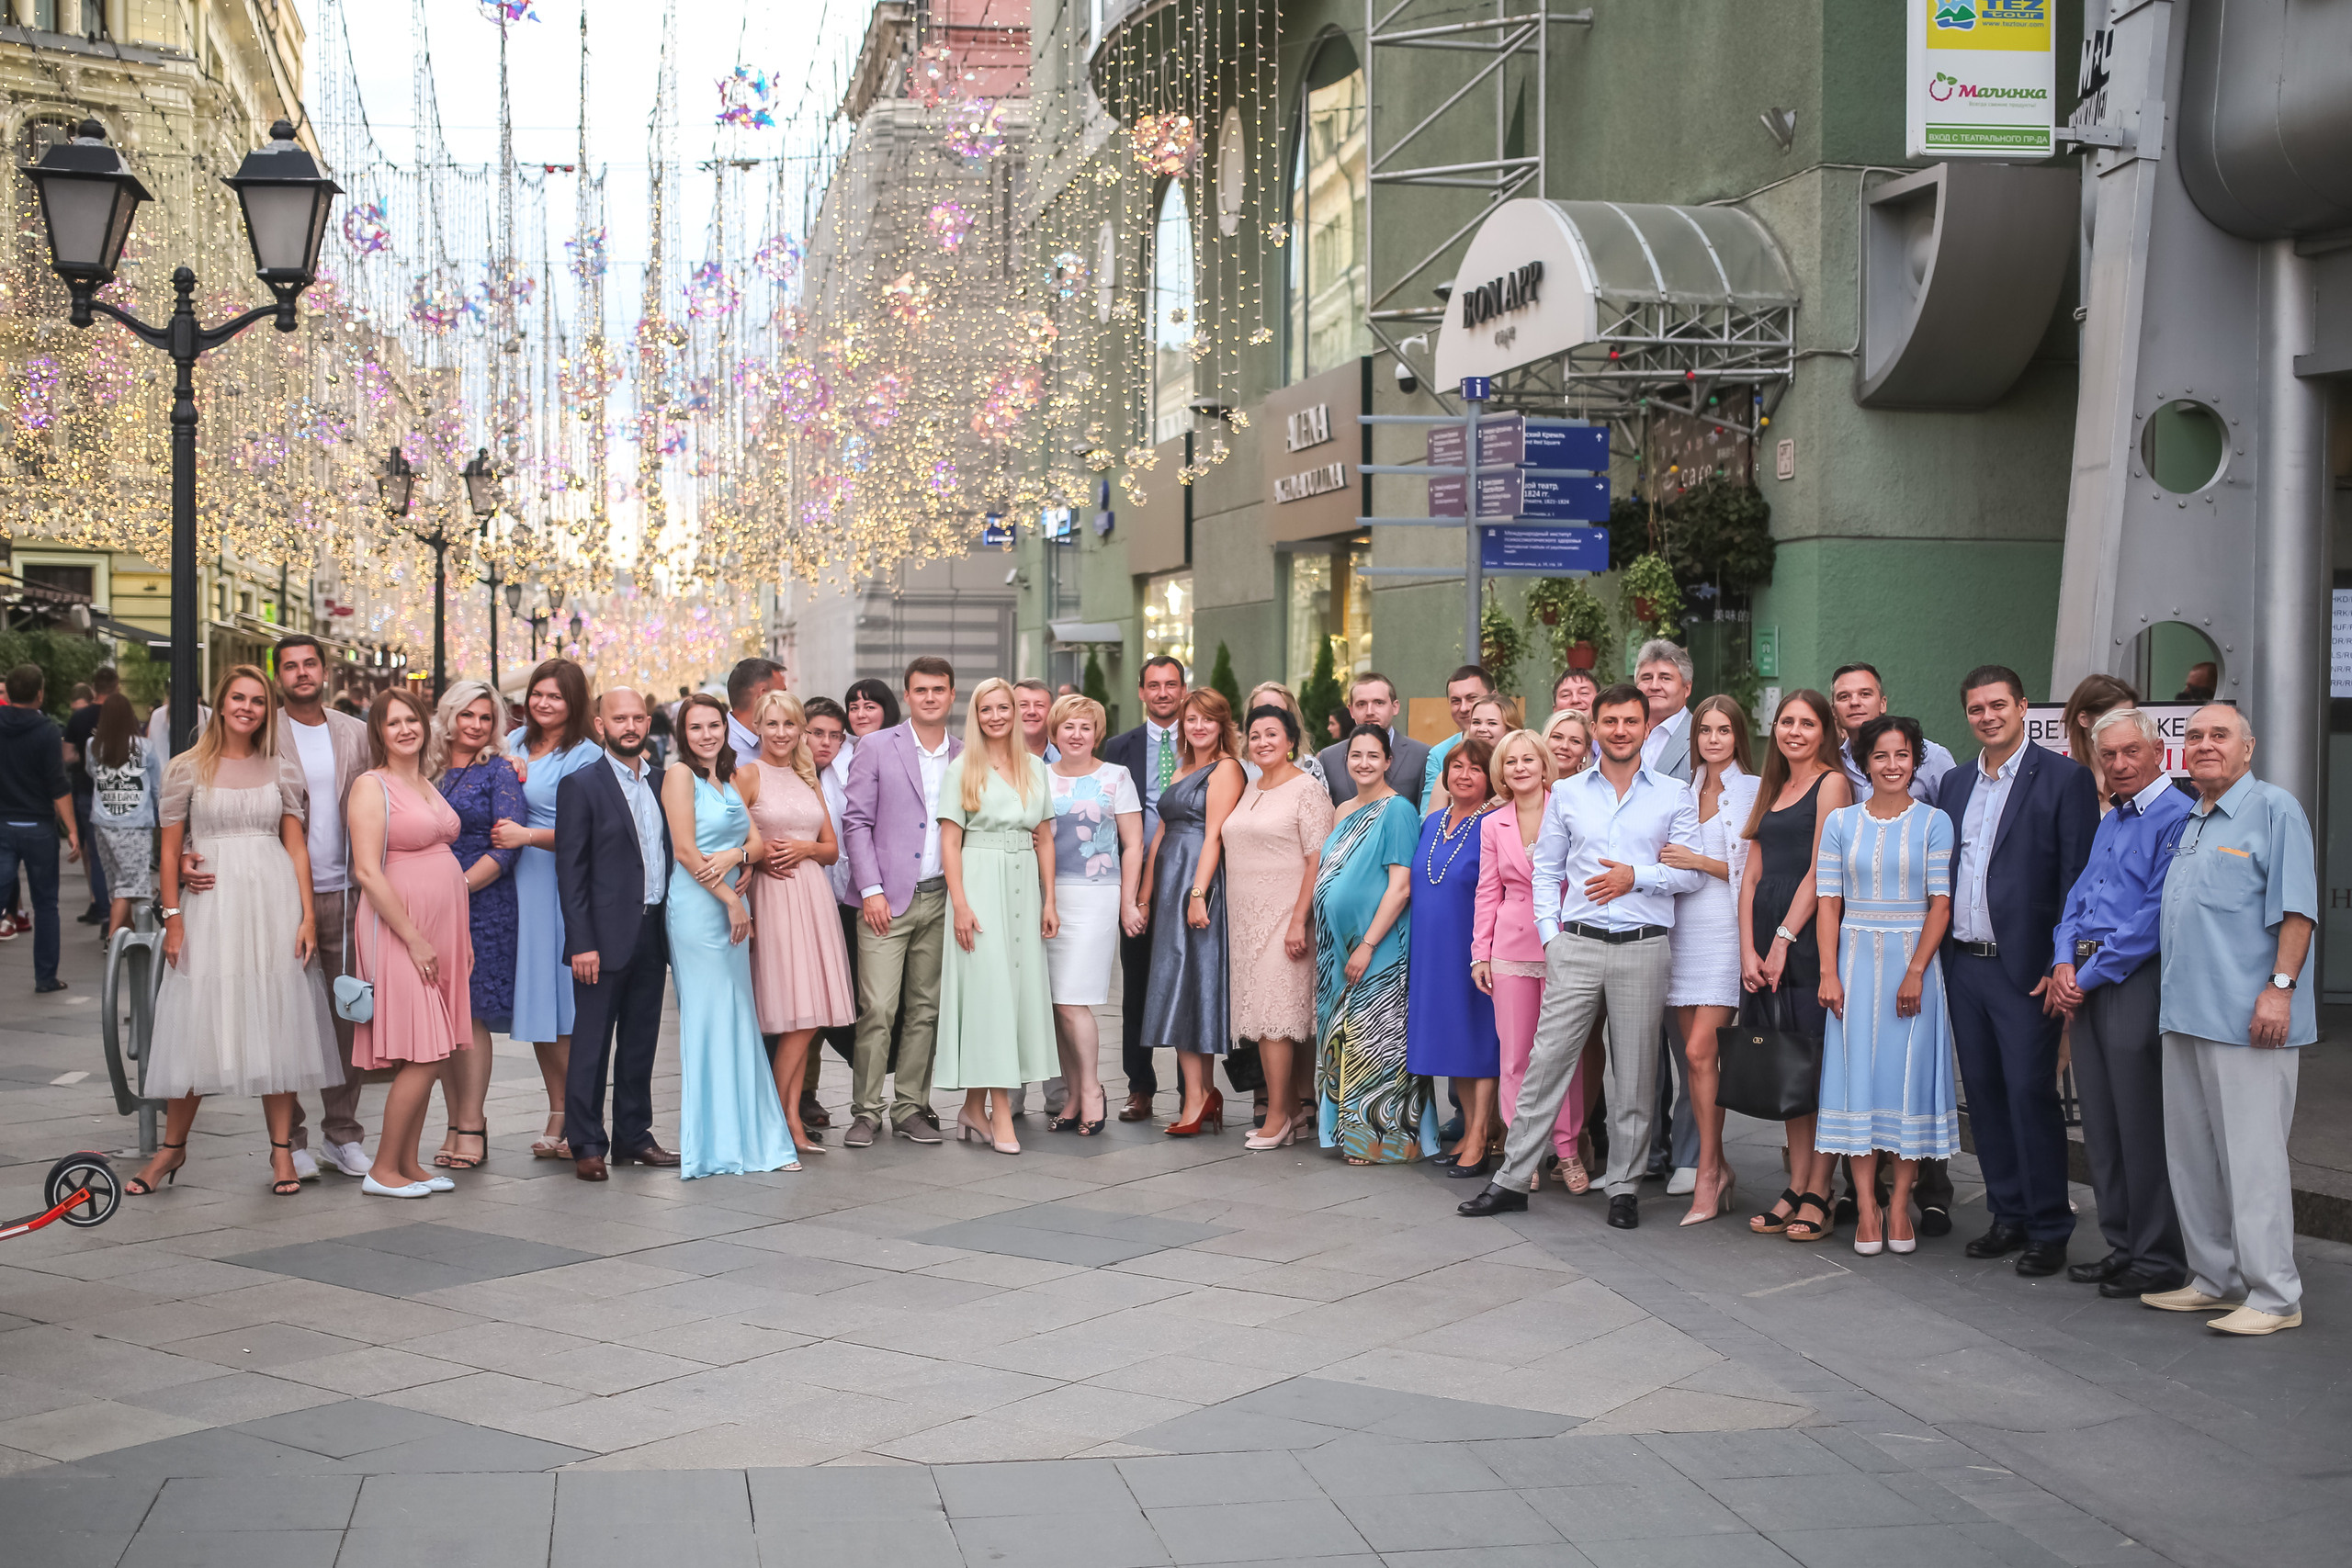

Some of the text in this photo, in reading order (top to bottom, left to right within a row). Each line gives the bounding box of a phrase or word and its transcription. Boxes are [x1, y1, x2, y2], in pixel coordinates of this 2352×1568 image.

[1987, 11, 2039, 19] tour
[1958, 85, 2048, 99] Малинка
[1928, 133, 1951, 143] ВХОД
[1960, 134, 2022, 142] ТЕАТРАЛЬНОГО
[2023, 135, 2048, 144] ПР-ДА
[1463, 261, 1544, 329] BON APP
[1285, 403, 1329, 454] ALENA
[1537, 483, 1559, 491] театр,
